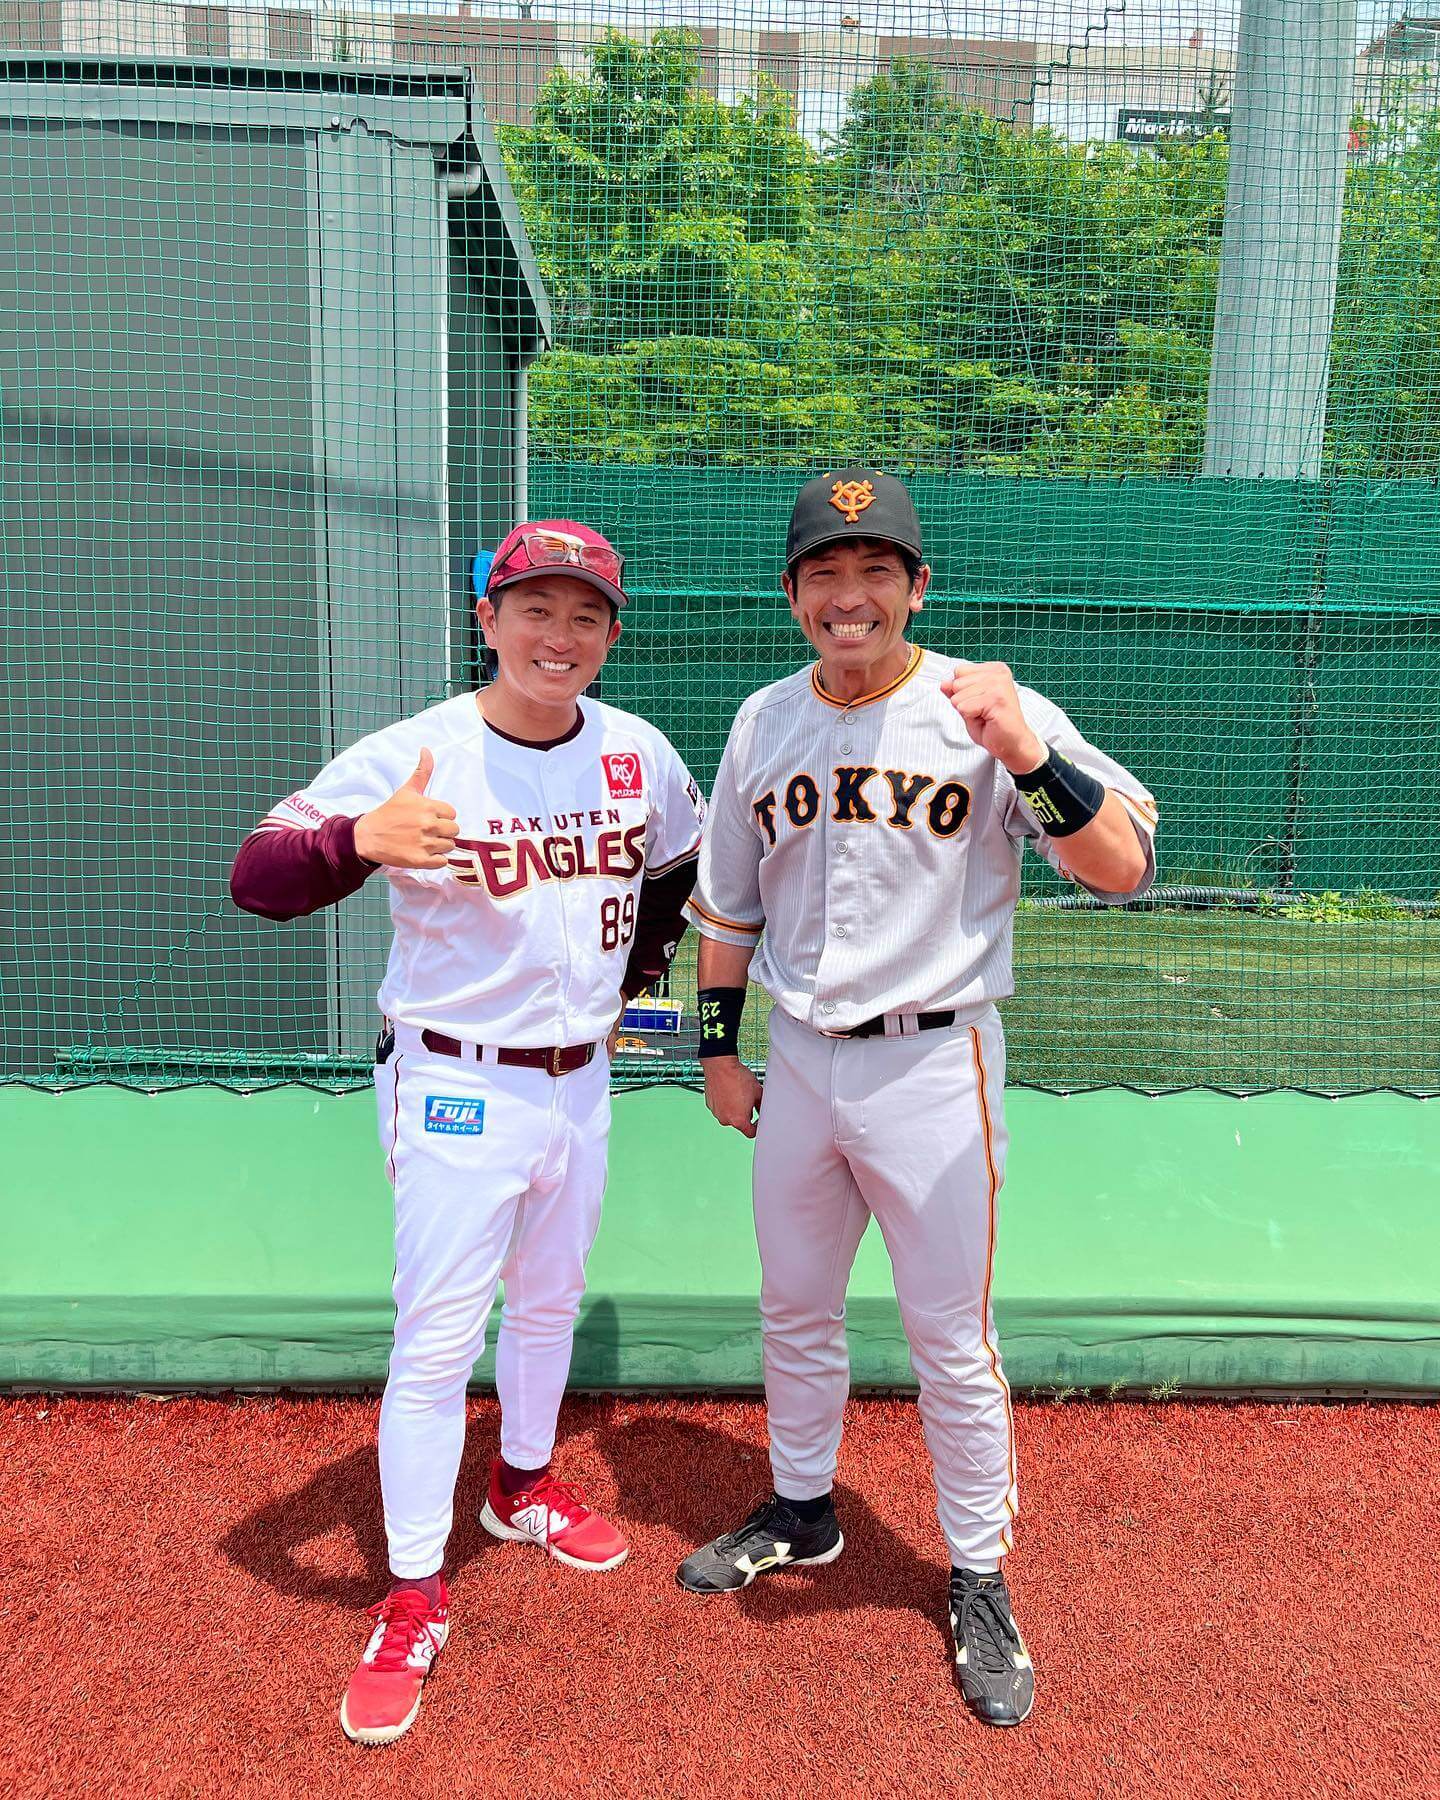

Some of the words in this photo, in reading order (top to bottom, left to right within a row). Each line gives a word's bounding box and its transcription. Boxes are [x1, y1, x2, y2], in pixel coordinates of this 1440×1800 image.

[287, 793, 328, 823] kuten
[487, 809, 621, 835] RAKUTEN
[752, 766, 972, 848] TOKYO
[447, 823, 647, 900] EAGLES
[600, 892, 636, 952] 89
[701, 1001, 721, 1021] 23
